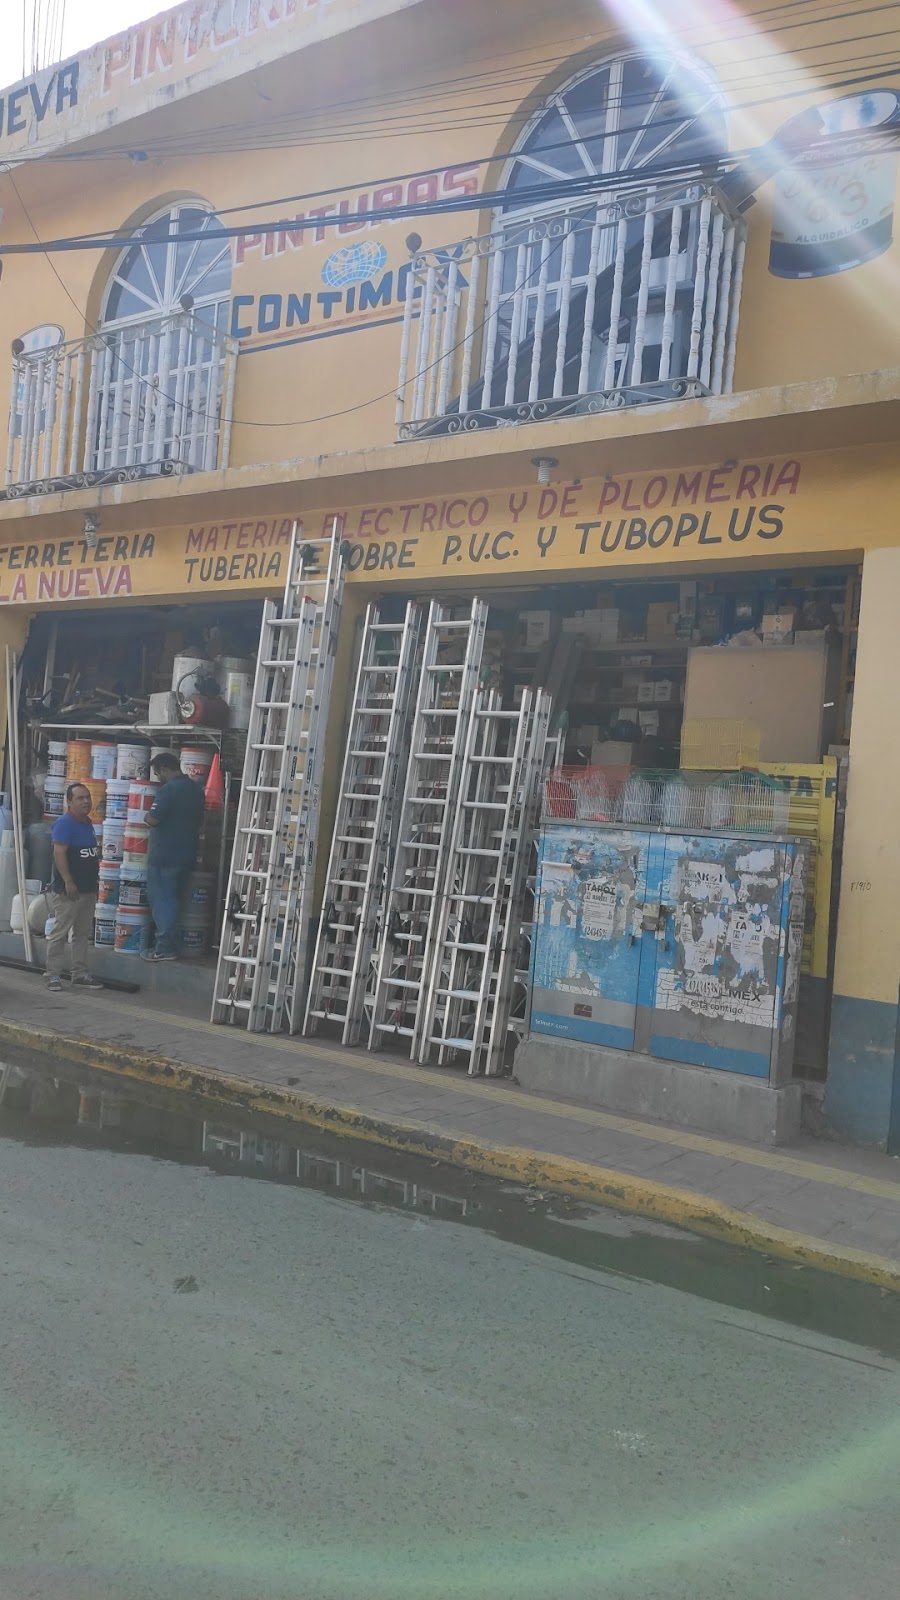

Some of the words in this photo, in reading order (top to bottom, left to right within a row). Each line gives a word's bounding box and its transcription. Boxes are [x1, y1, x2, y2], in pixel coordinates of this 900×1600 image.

[0, 61, 79, 137] EVA
[233, 164, 480, 266] PINTURAS
[795, 218, 869, 243] ALQUIDALICO
[185, 518, 297, 554] MATERIA
[320, 496, 490, 539] ELECTRICO
[509, 491, 528, 523] Y
[537, 484, 584, 519] DE
[597, 460, 801, 514] PLOMERIA
[185, 551, 282, 583] TUBERIA
[345, 538, 419, 572] OBRE
[442, 531, 519, 565] P.V.C.
[537, 526, 558, 558] Y
[575, 504, 785, 554] TUBOPLUS
[38, 564, 133, 600] NUEVA
